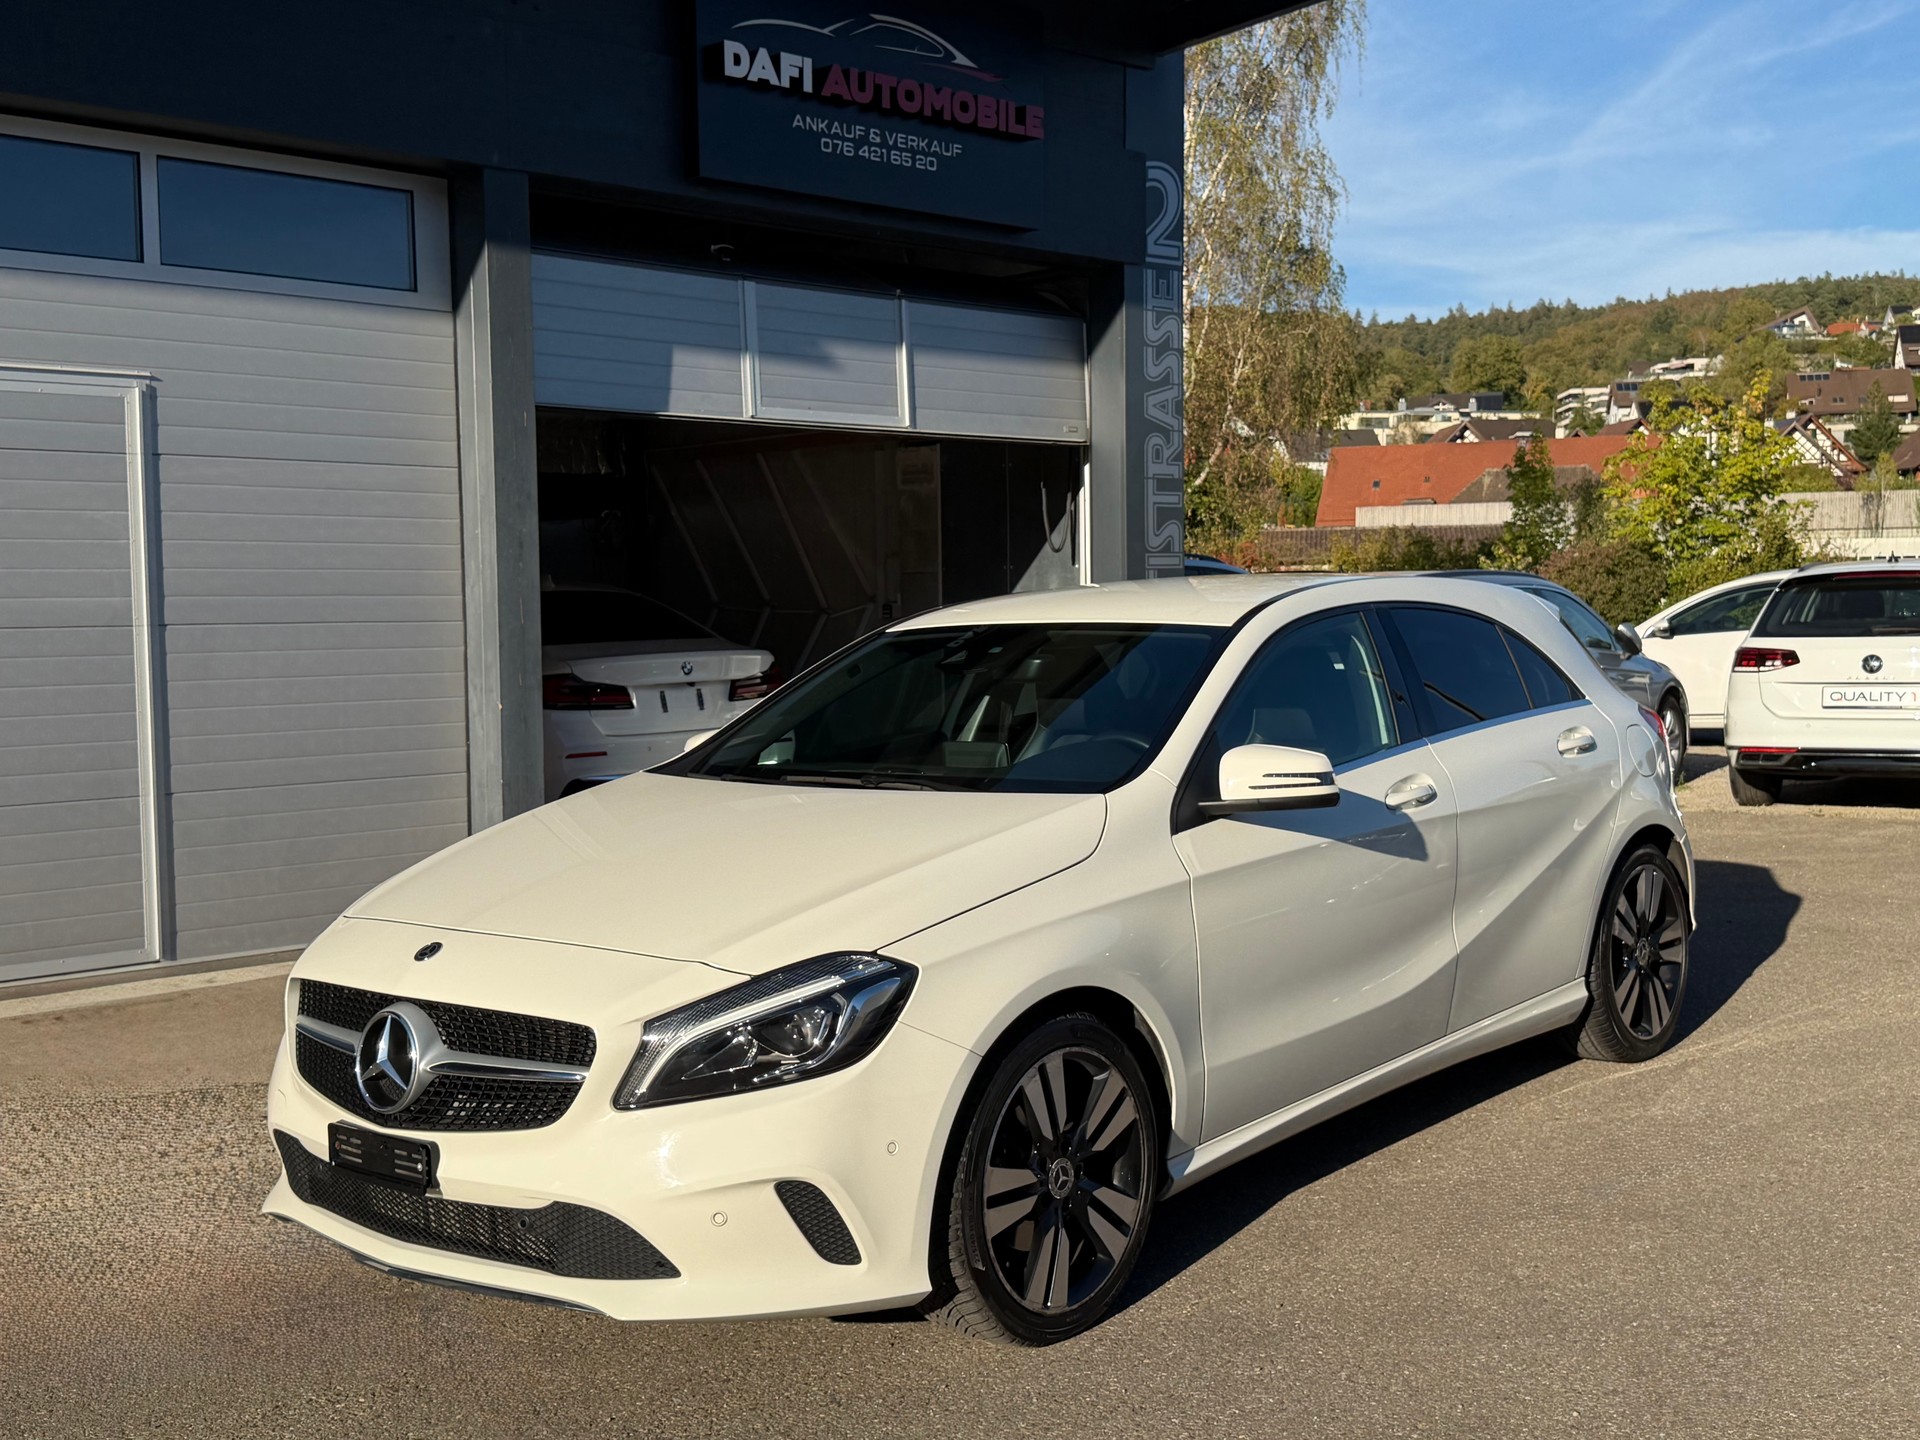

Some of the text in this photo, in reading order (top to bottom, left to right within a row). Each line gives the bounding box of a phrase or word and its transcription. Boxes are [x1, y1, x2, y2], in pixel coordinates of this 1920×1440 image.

[724, 39, 1044, 139] DAFI AUTOMOBILE
[792, 114, 963, 157] ANKAUF & VERKAUF
[820, 138, 937, 171] 076 421 65 20
[1143, 268, 1183, 580] ISTRASSE
[1830, 691, 1907, 702] QUALITY
